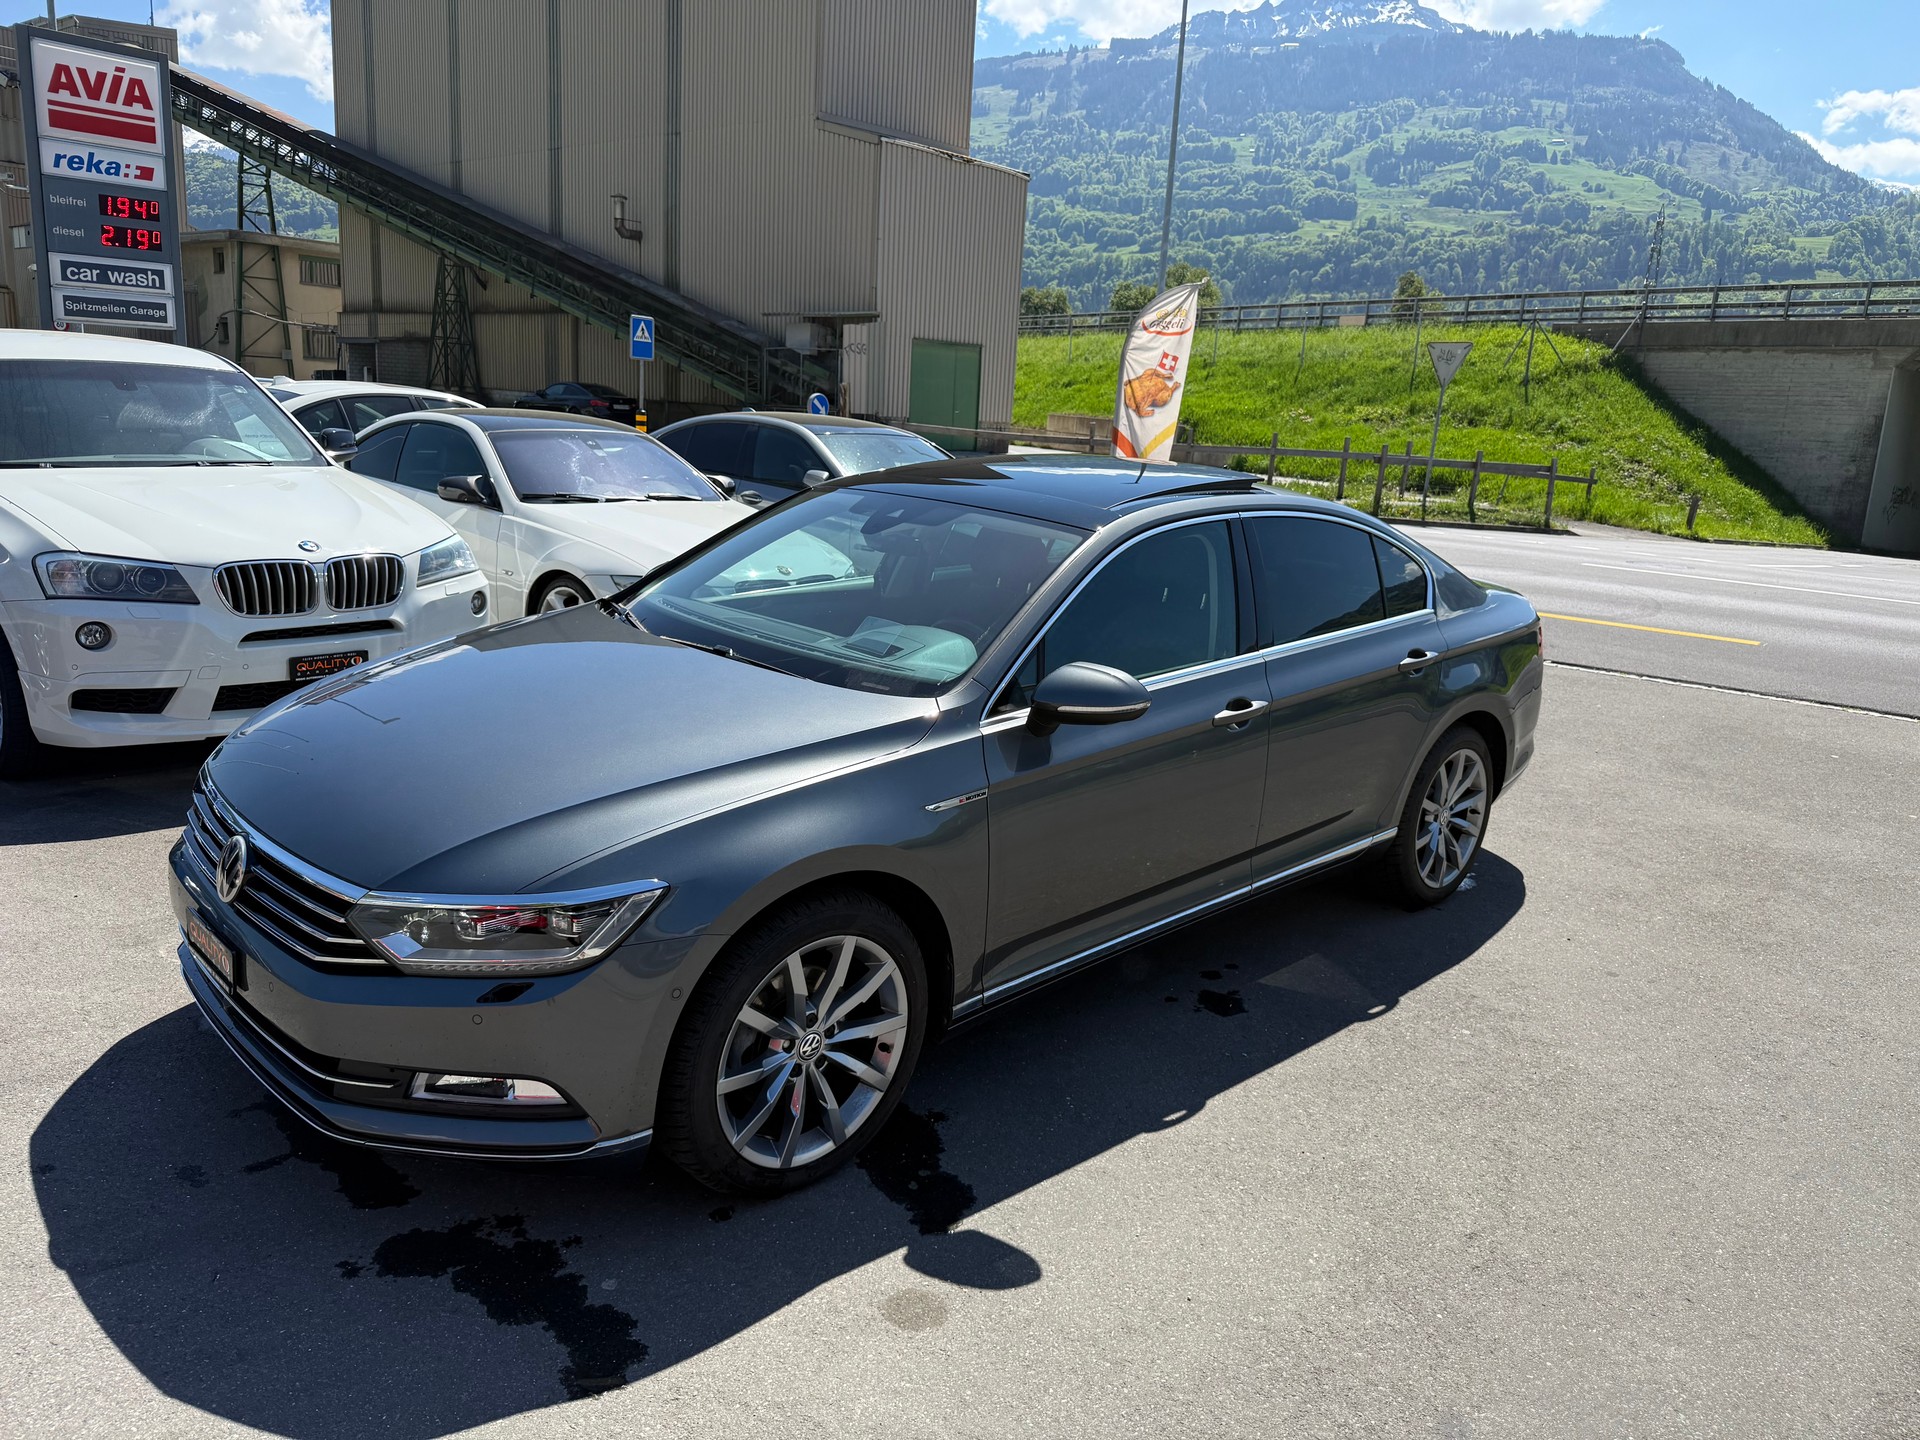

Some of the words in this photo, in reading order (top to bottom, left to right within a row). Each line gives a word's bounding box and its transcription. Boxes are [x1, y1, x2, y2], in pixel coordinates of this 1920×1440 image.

[49, 194, 87, 207] bleifrei
[52, 225, 85, 237] diesel
[66, 266, 100, 282] car
[107, 270, 160, 288] wash
[65, 300, 126, 313] Spitzmeilen
[129, 305, 166, 318] Garage
